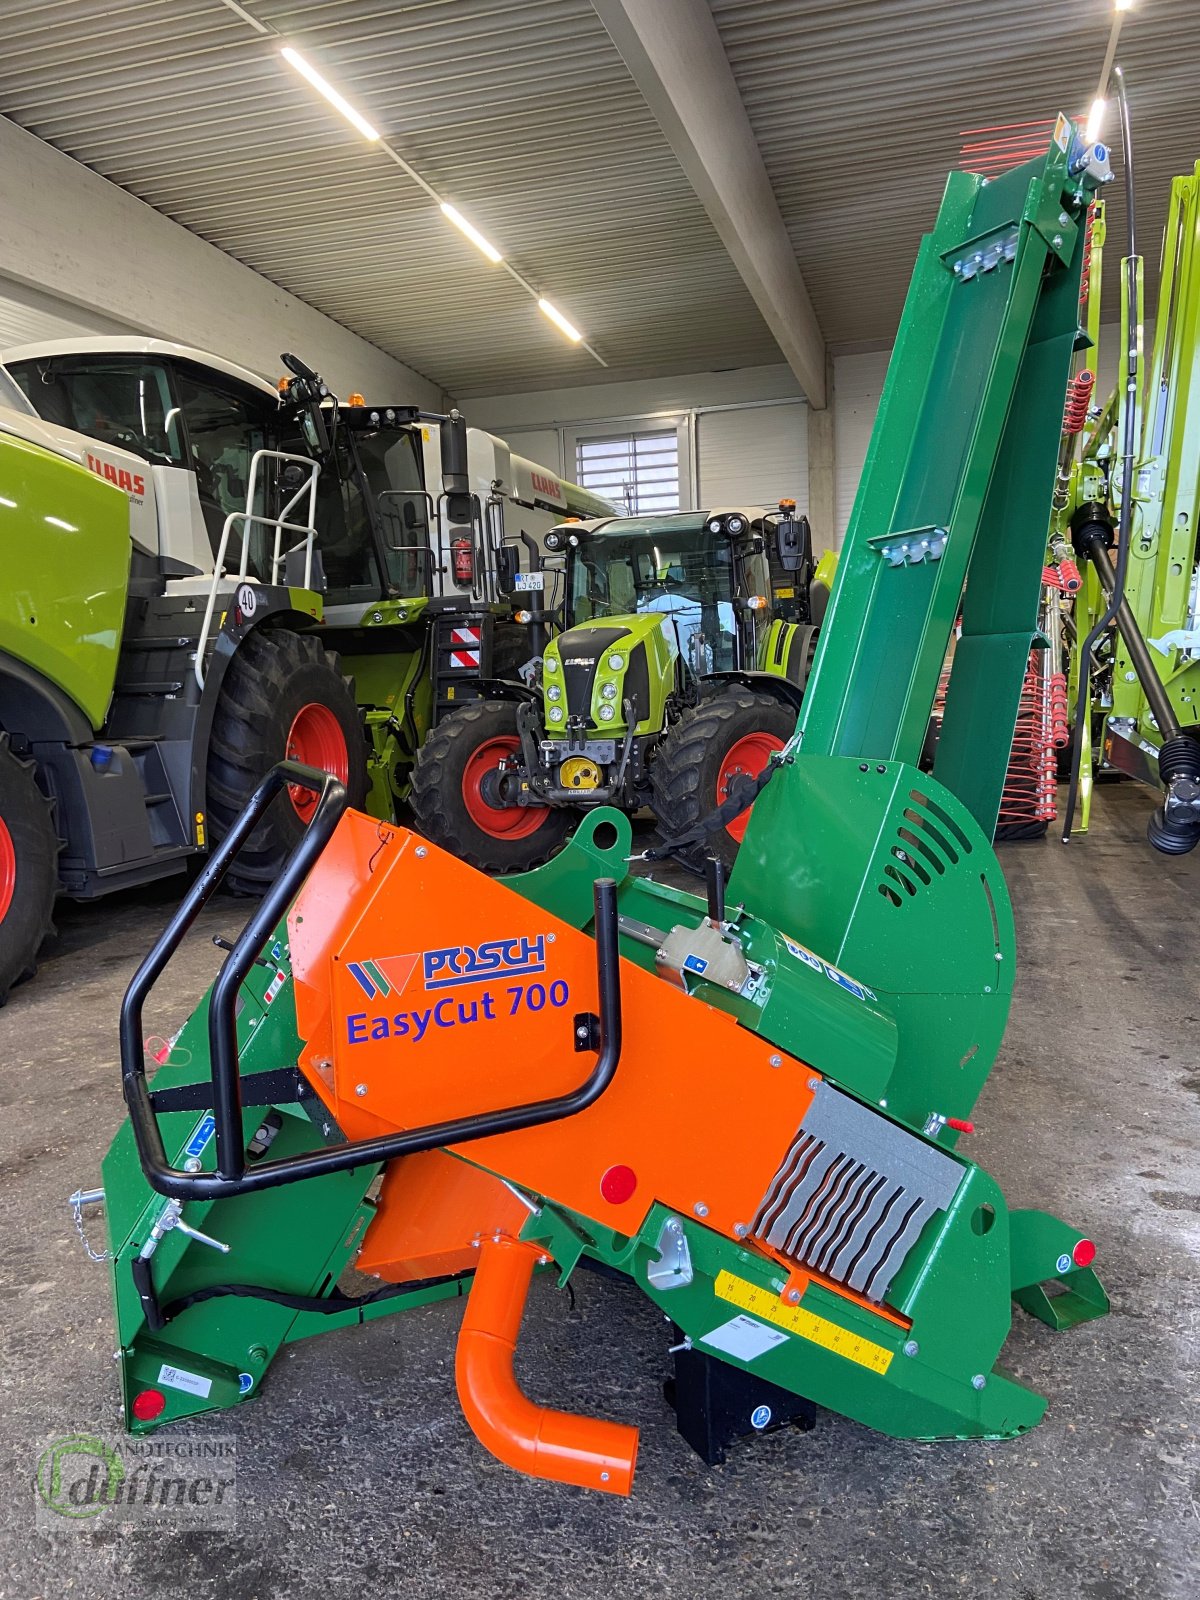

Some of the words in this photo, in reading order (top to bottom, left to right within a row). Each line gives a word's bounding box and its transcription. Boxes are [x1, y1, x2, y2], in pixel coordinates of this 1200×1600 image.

[88, 454, 145, 496] CLAAS
[530, 472, 561, 499] CLAAS
[242, 590, 254, 610] 40
[422, 934, 545, 980] POSCH
[346, 991, 497, 1045] EasyCut
[506, 979, 570, 1016] 700
